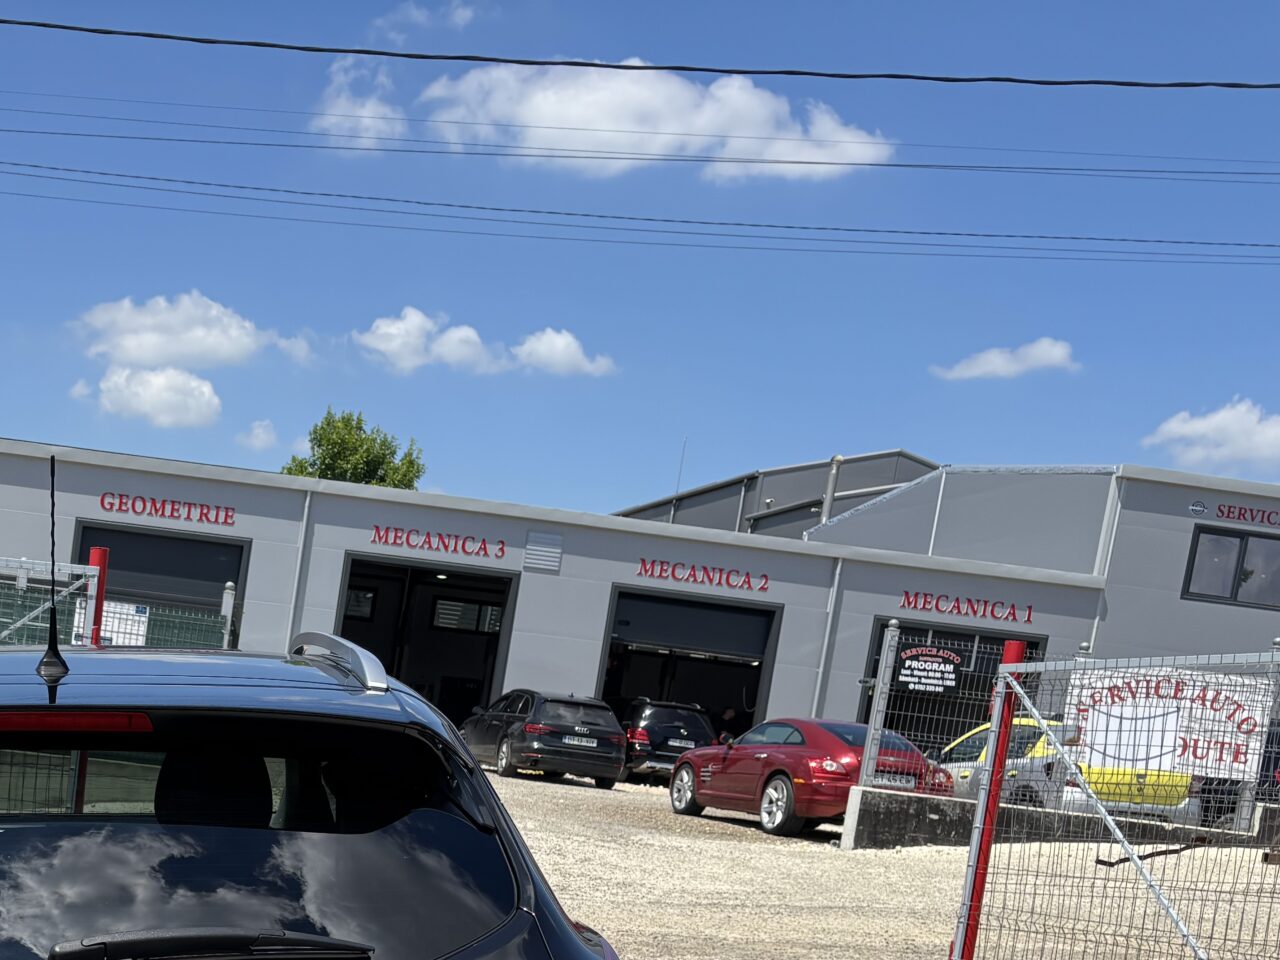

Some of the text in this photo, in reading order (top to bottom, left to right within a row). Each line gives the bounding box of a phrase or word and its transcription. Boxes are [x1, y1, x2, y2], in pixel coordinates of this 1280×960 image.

[99, 491, 236, 525] GEOMETRIE
[1216, 504, 1280, 527] SERVIC
[370, 525, 506, 558] MECANICA 3
[636, 557, 770, 592] MECANICA 2
[899, 590, 1034, 624] MECANICA 1
[900, 647, 938, 660] SERVICE
[938, 649, 961, 664] AUTO
[905, 659, 954, 672] PROGRAM
[1190, 686, 1258, 735] AUTO
